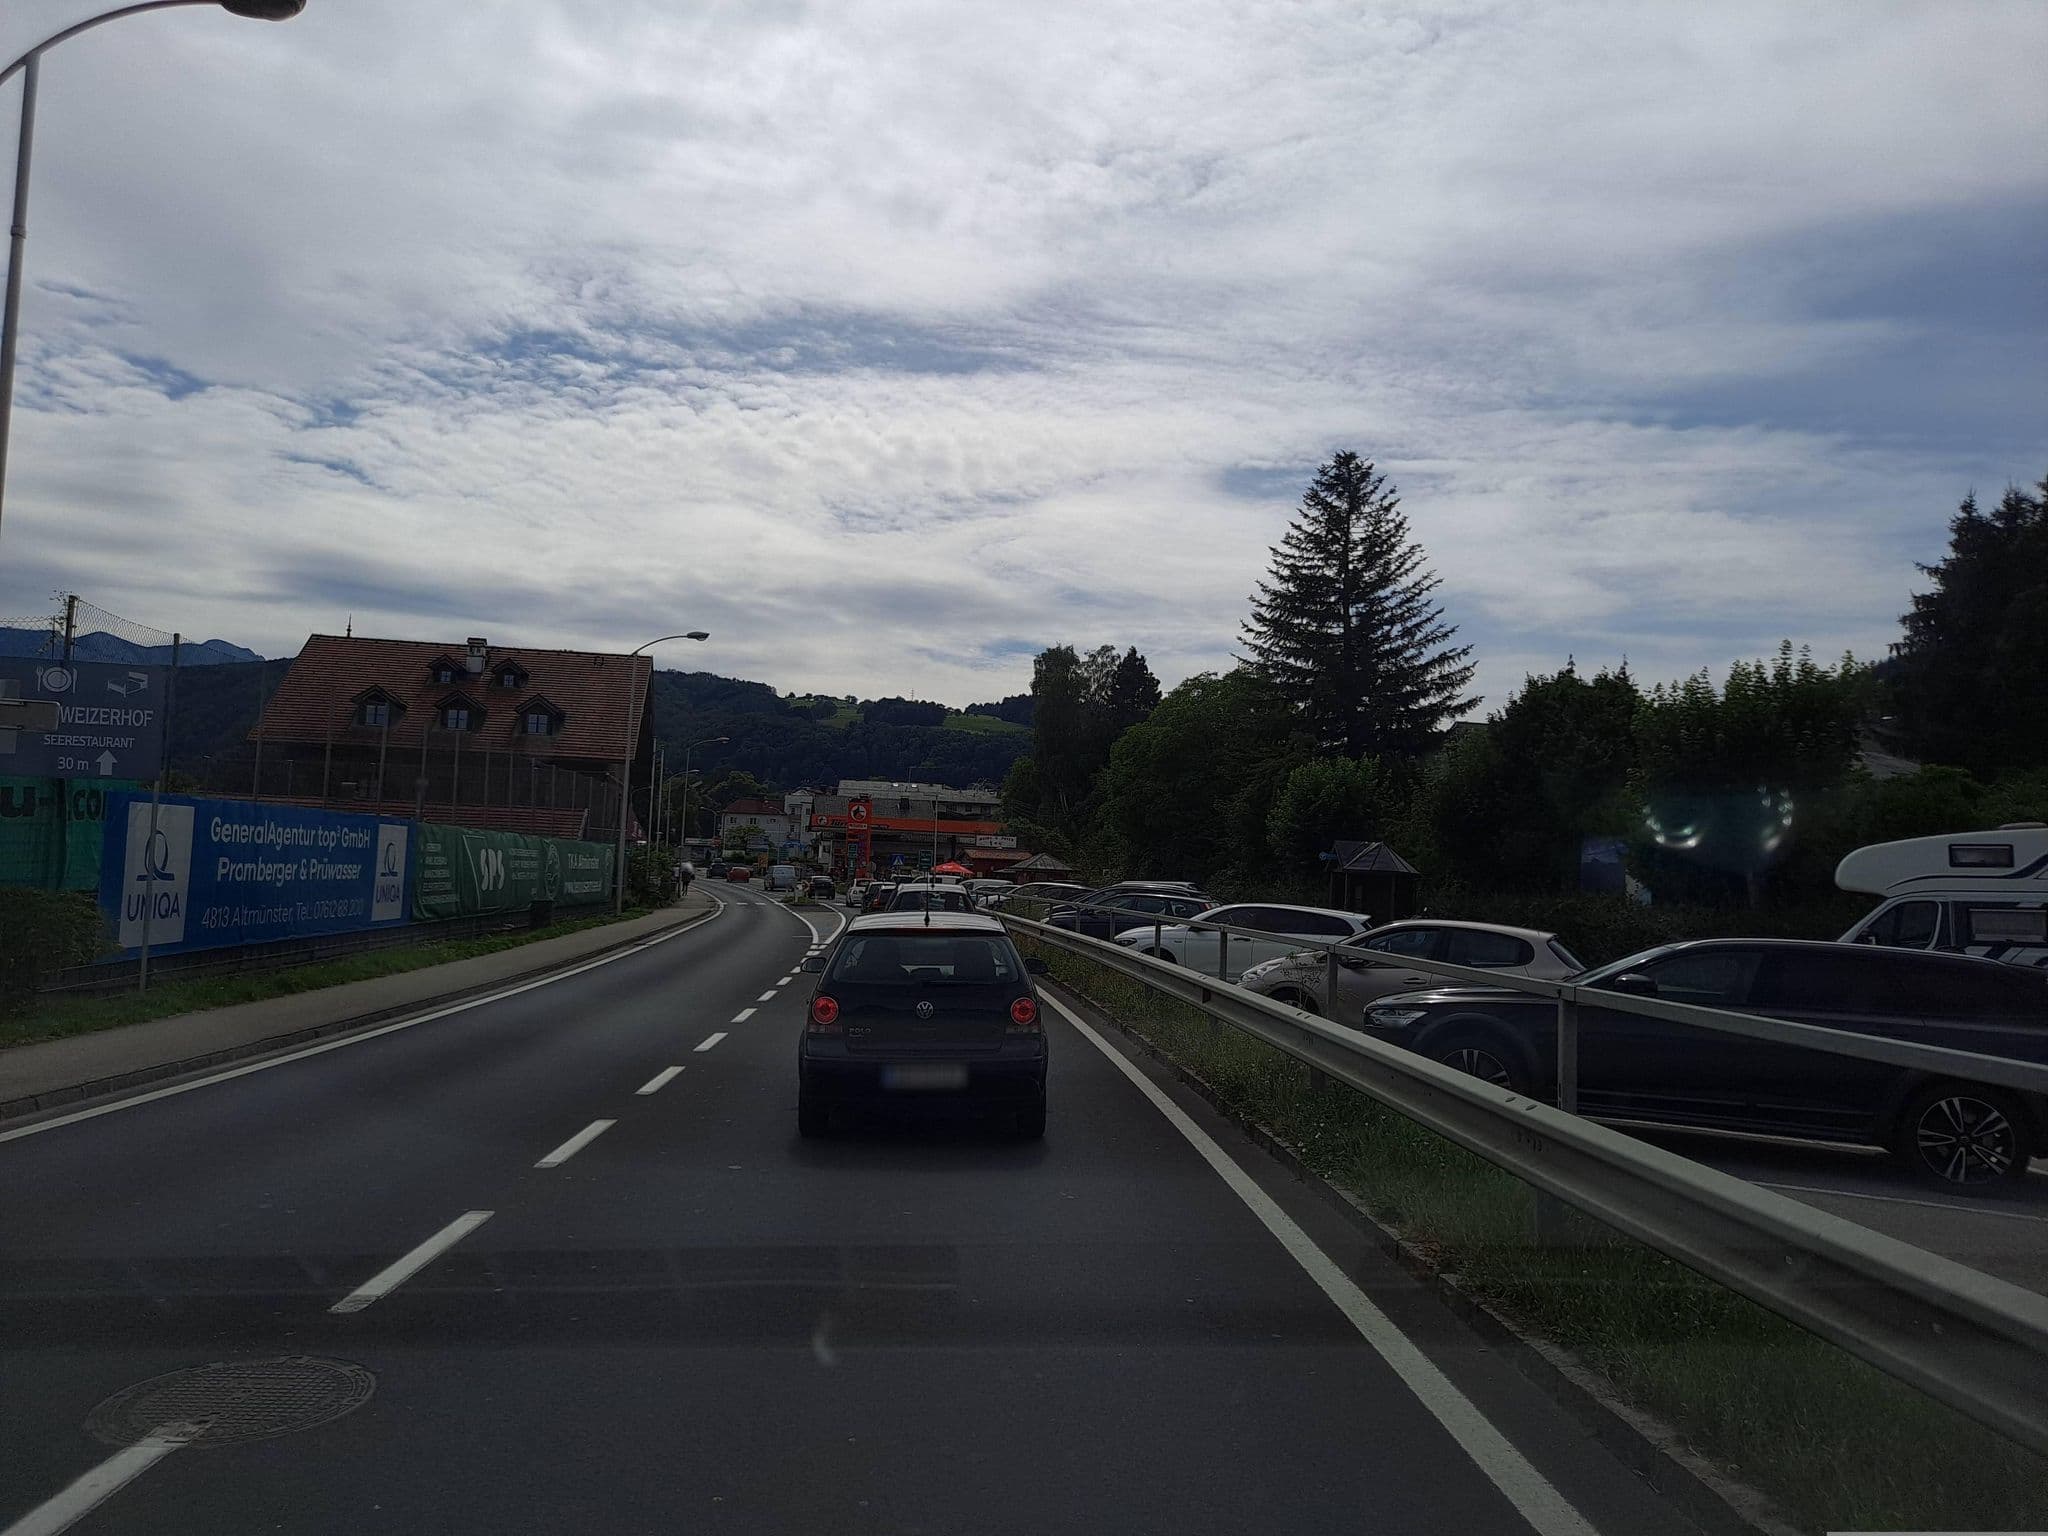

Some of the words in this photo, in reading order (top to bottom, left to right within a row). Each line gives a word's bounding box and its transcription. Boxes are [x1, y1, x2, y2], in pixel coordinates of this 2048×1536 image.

[60, 706, 153, 727] WEIZERHOF
[43, 734, 135, 749] SEERESTAURANT
[57, 756, 73, 770] 30
[77, 759, 89, 770] m
[210, 816, 315, 851] GeneralAgentur
[341, 826, 371, 849] GmbH
[217, 856, 298, 887] Promberger
[300, 858, 308, 880] &
[376, 883, 401, 904] UNIQA
[127, 892, 181, 922] UNIQA
[201, 905, 230, 929] 4813
